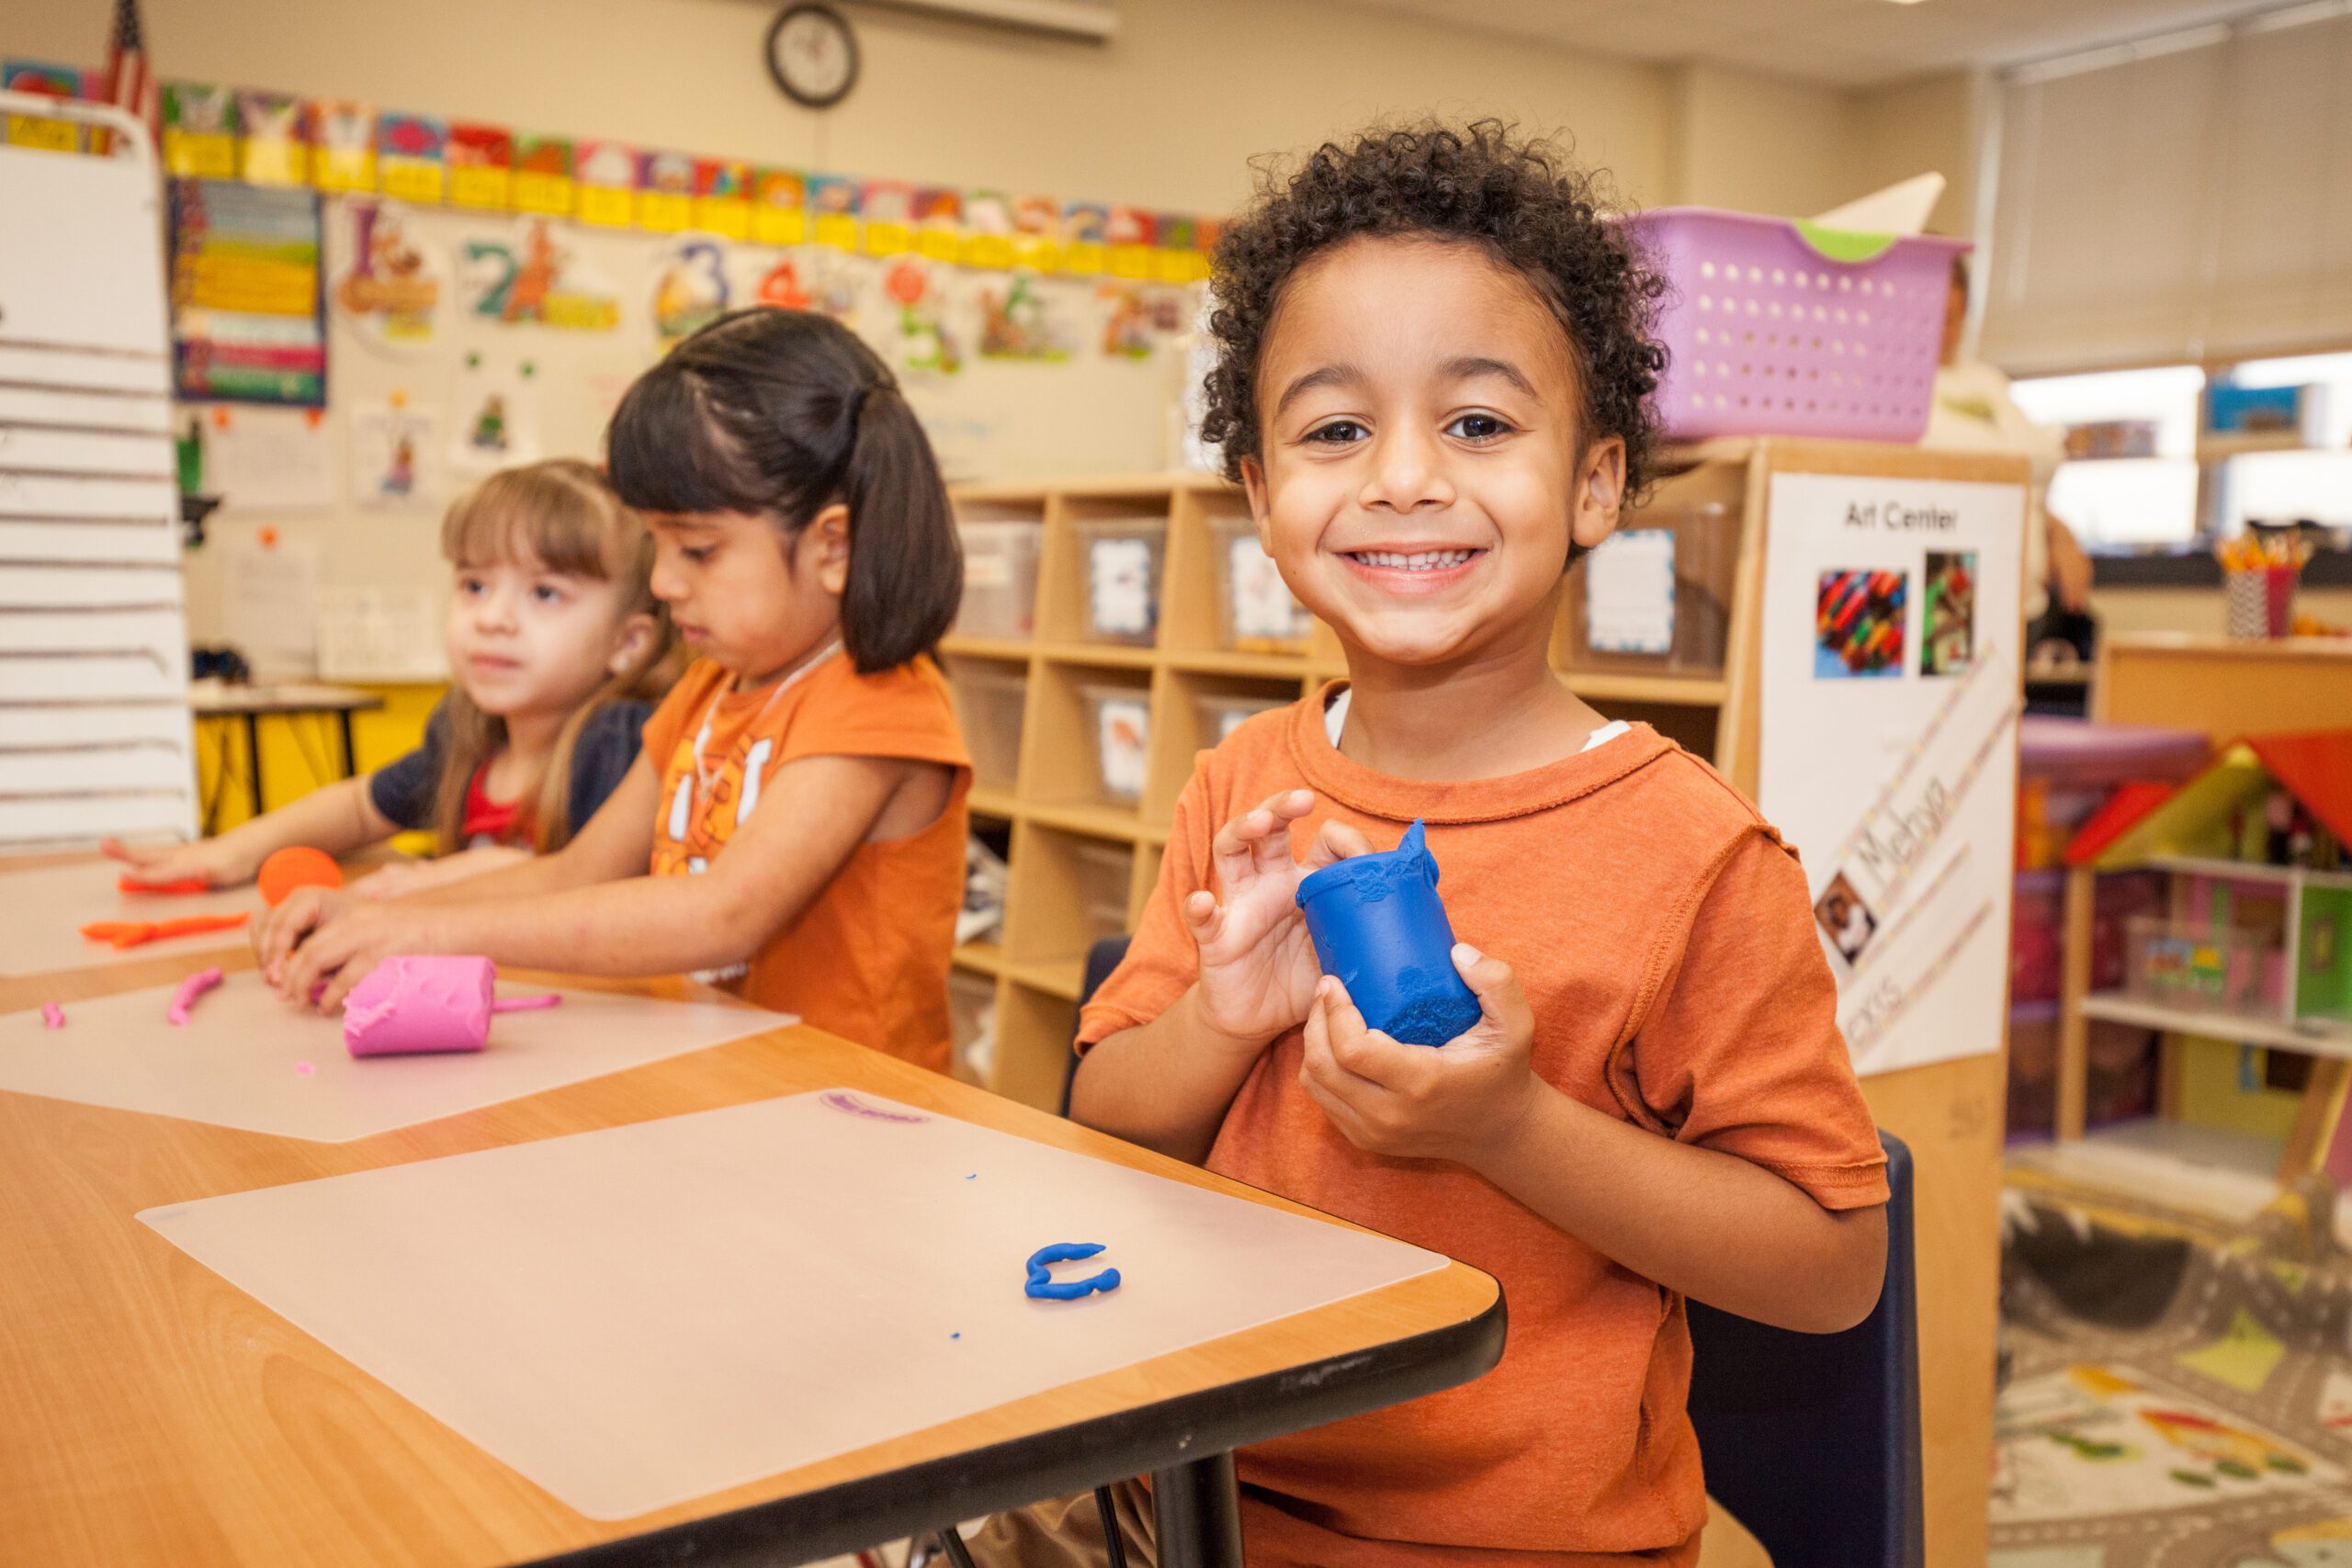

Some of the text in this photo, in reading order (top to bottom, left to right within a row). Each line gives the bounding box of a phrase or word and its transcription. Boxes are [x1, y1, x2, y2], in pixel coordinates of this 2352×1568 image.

[466, 240, 519, 316] 2
[755, 258, 813, 312] 4
[1844, 501, 1959, 533] Art Center
